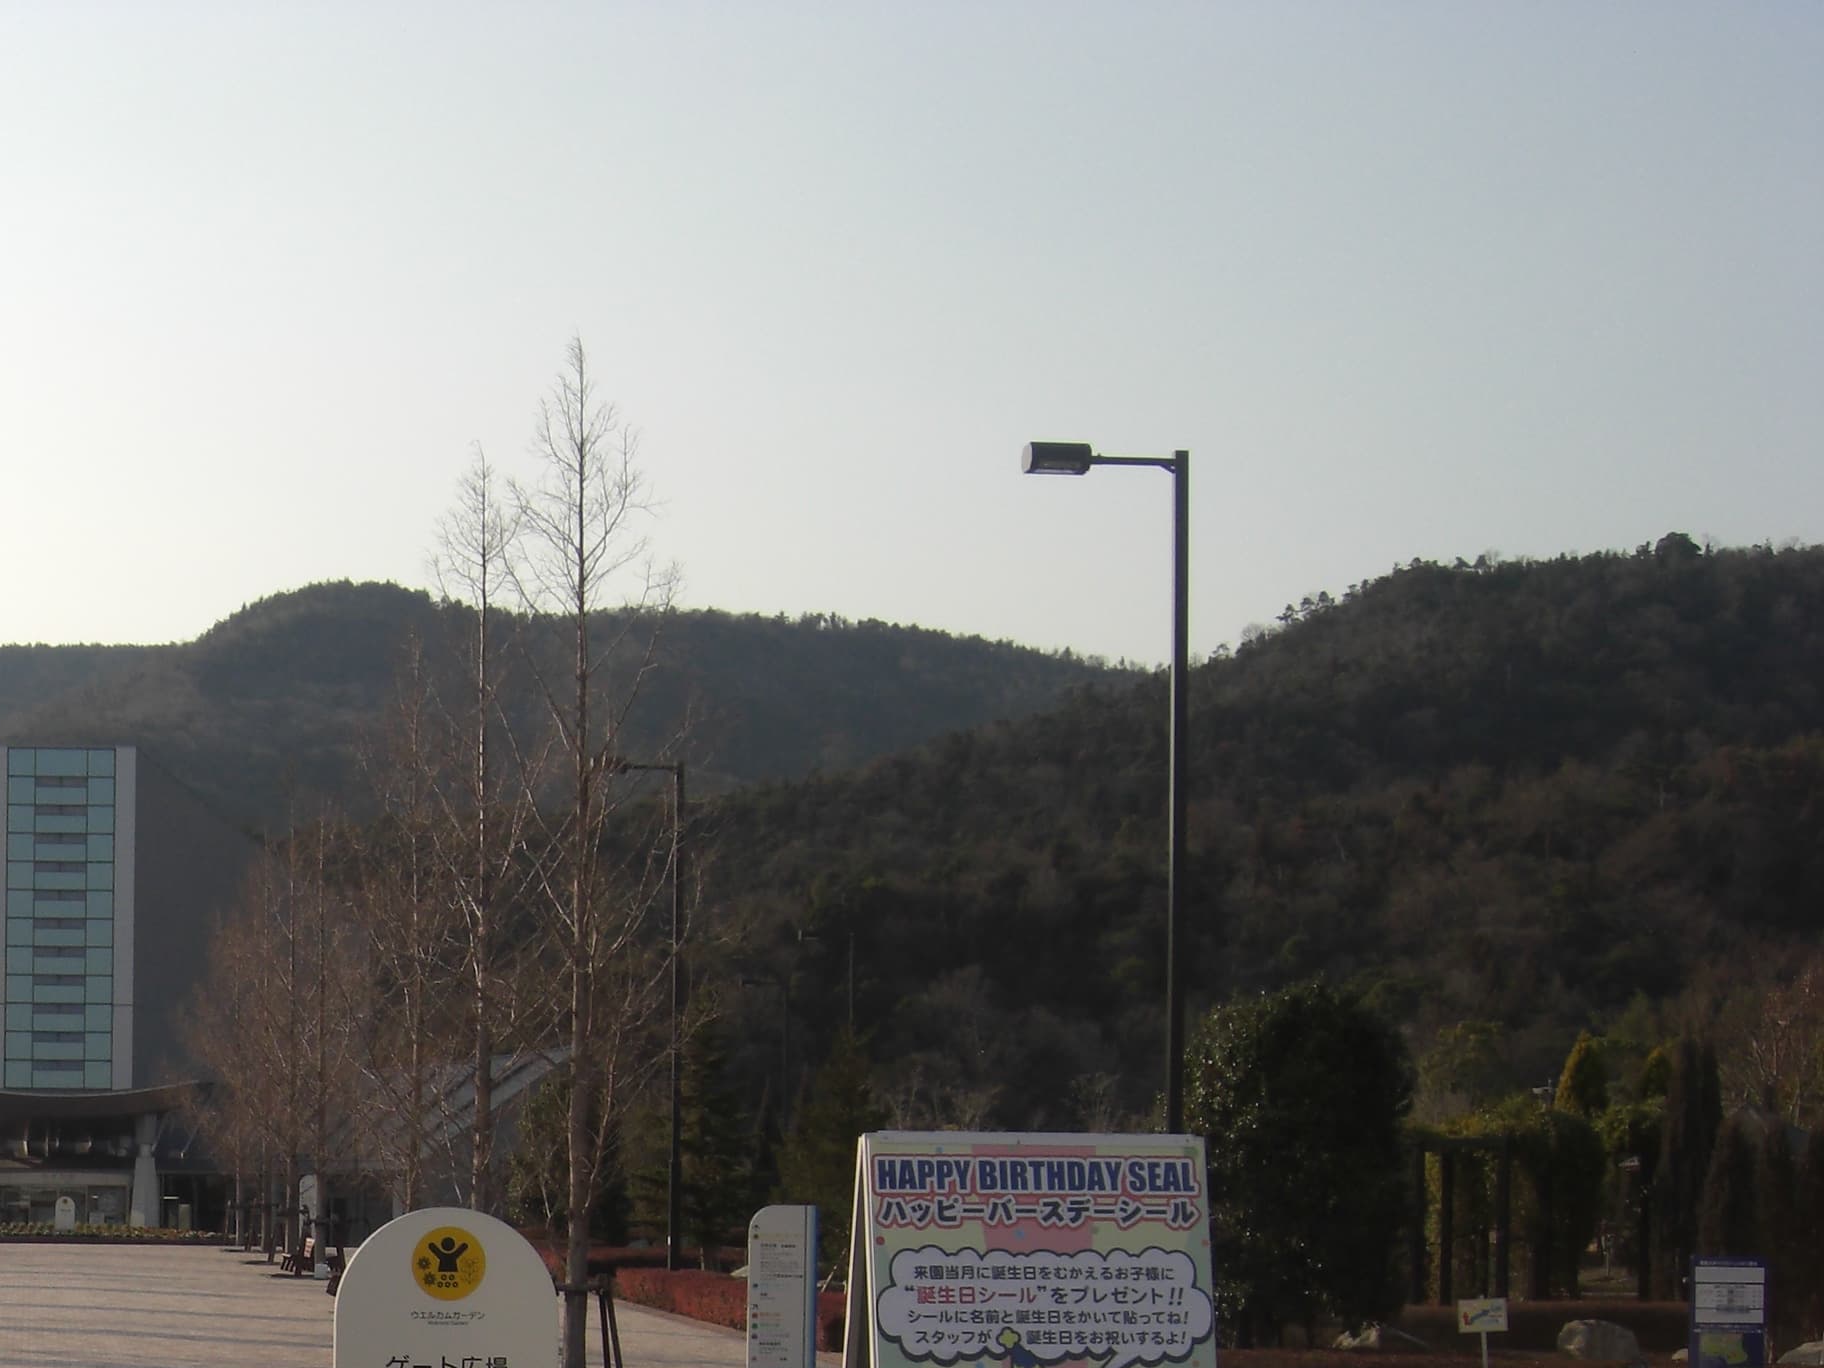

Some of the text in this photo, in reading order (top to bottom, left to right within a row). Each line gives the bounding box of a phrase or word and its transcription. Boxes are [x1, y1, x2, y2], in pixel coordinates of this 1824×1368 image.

[877, 1159, 1196, 1193] HAPPY BIRTHDAY SEAL
[881, 1197, 1196, 1224] ハッピーバースデーシール
[913, 1264, 1175, 1281] 来園当月に誕生日をむかえるお子様に
[915, 1329, 993, 1345] スタッフが
